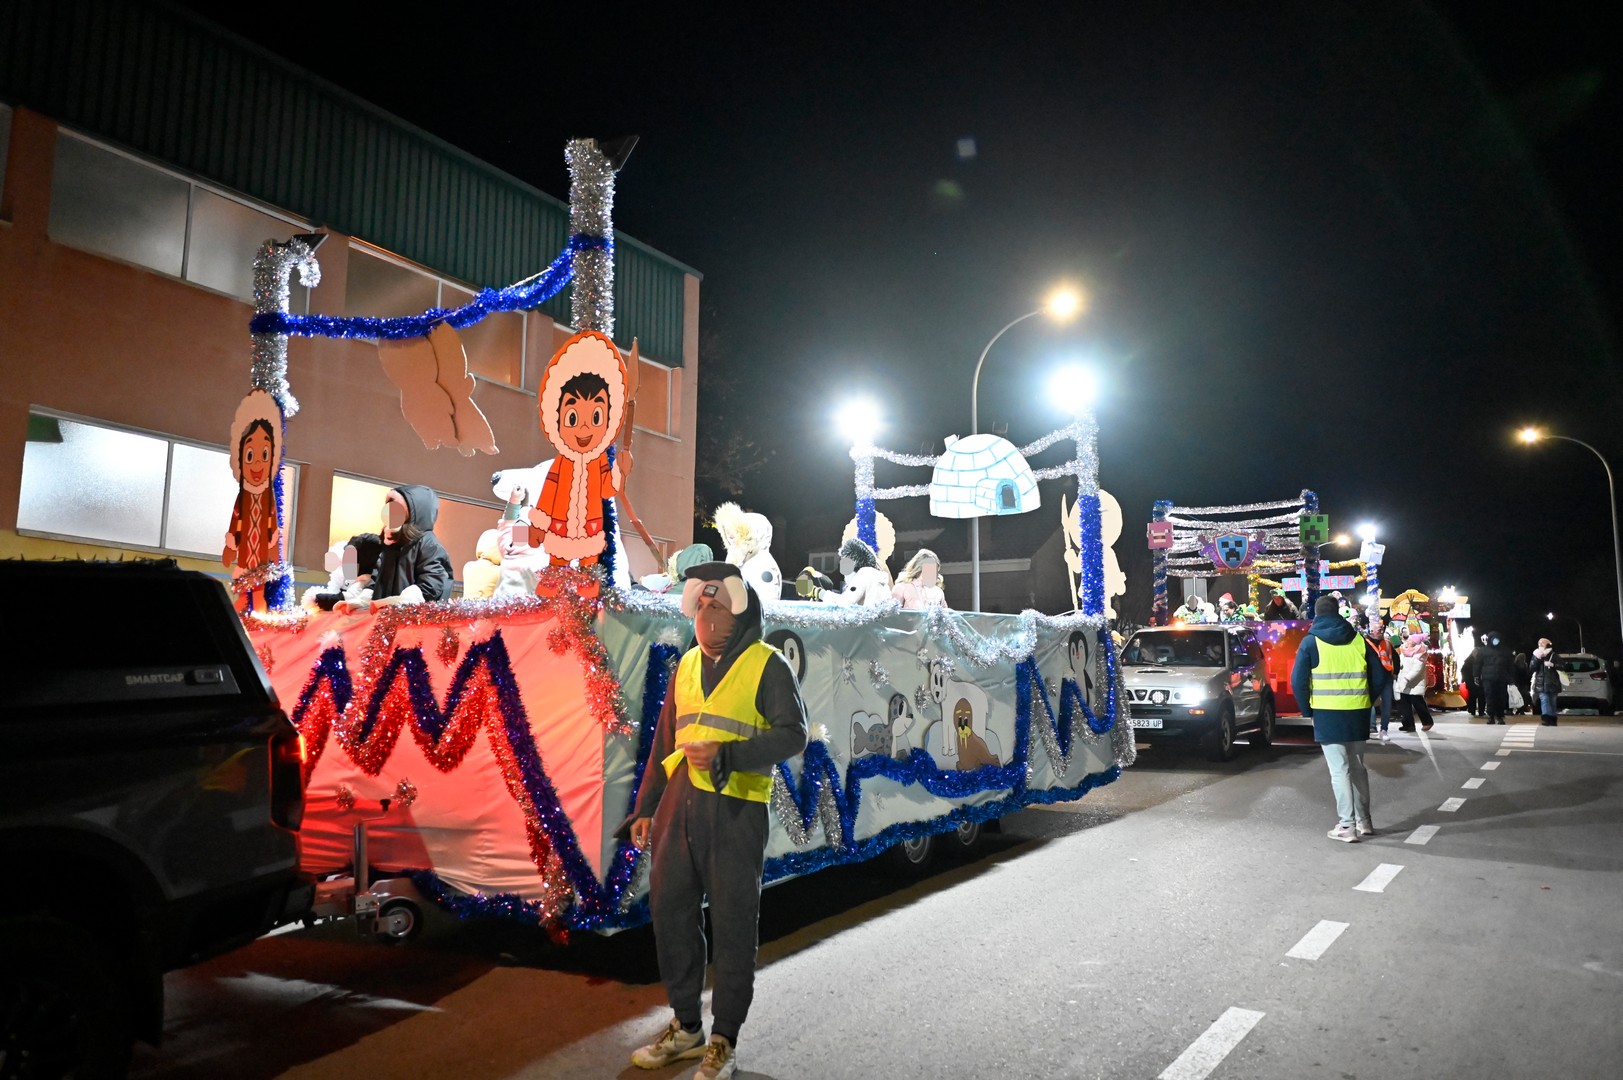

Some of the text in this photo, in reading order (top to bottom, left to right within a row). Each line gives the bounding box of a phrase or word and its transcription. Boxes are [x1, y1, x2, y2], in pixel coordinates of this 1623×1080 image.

[1282, 575, 1355, 591] VALMERA
[125, 673, 184, 685] SMARTCAP
[1153, 719, 1162, 727] UP
